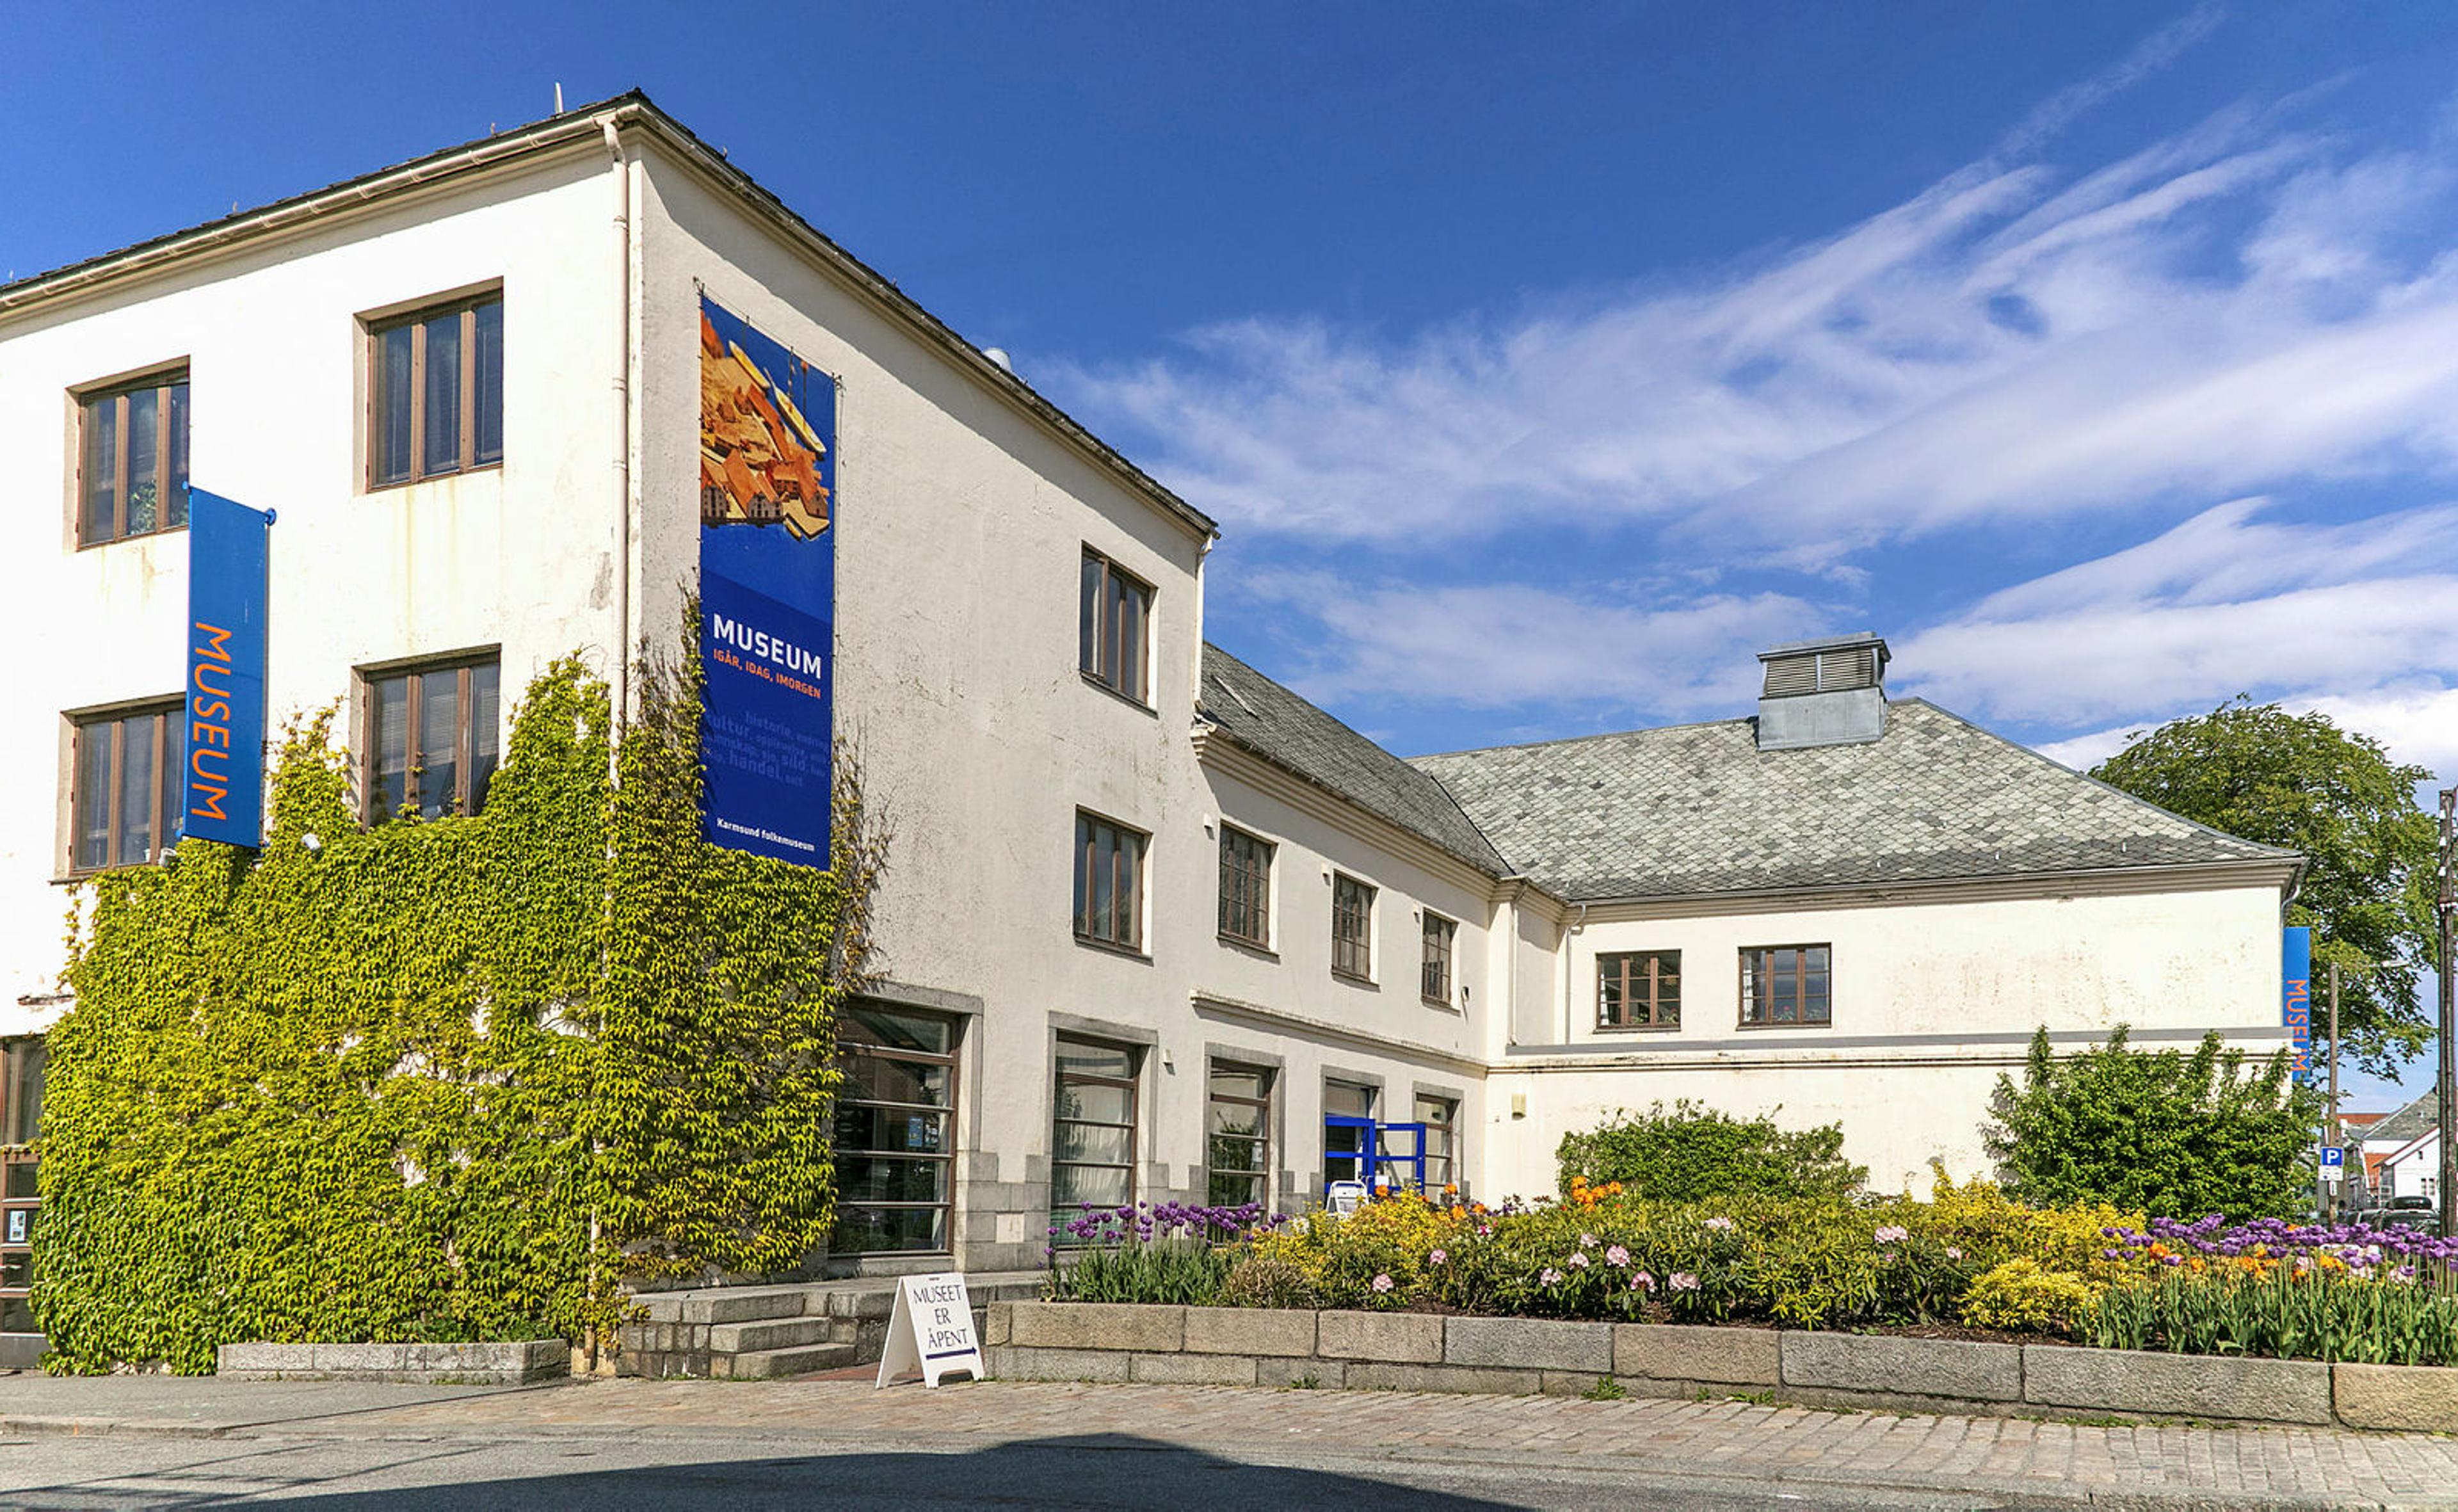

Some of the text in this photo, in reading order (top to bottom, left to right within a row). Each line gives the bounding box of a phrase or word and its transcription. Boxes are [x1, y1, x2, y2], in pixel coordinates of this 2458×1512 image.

[714, 613, 821, 679] MUSEUM
[714, 648, 821, 699] IGÅR, IDAG, IMORGEN
[191, 622, 232, 820] MUSEUM
[716, 817, 815, 852] Karmsund folkemuseum
[2327, 1150, 2339, 1164] P
[913, 1284, 961, 1304] MUSEET
[935, 1308, 951, 1325] ER
[928, 1327, 968, 1349] ÅPENT
